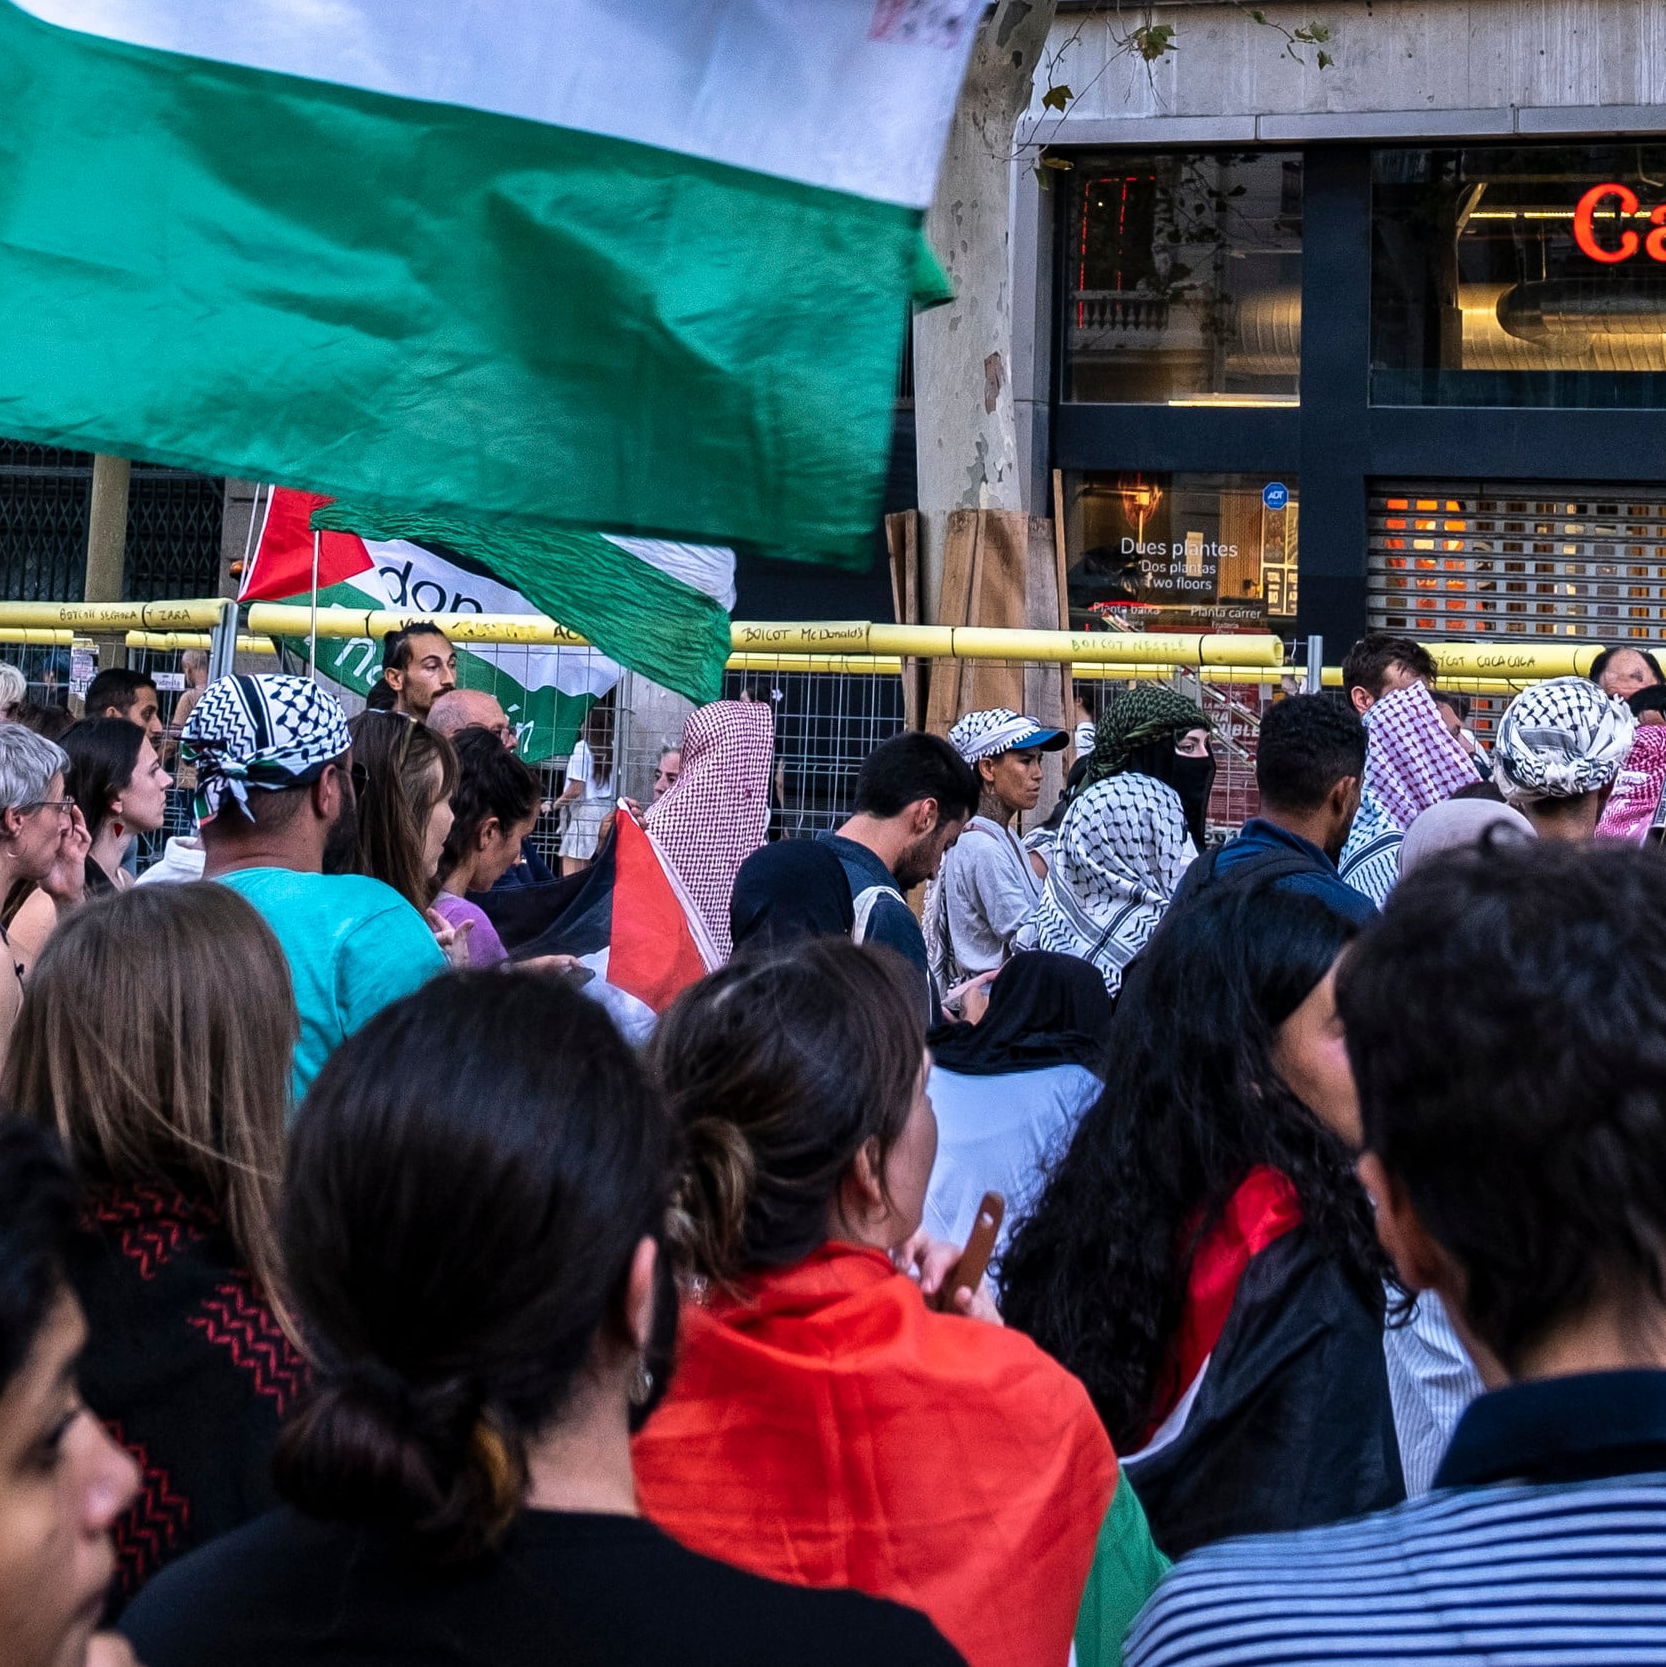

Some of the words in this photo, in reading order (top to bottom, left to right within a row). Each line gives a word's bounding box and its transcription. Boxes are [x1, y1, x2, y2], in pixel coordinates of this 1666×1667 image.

[1267, 490, 1286, 502] ADT
[1120, 537, 1167, 556] Dues
[1172, 540, 1238, 559] plantes
[1169, 561, 1217, 576] plantas
[1176, 576, 1213, 591] floors
[1190, 606, 1226, 619] Planta
[1228, 607, 1262, 620] carrer
[1071, 638, 1125, 654] BOICOT
